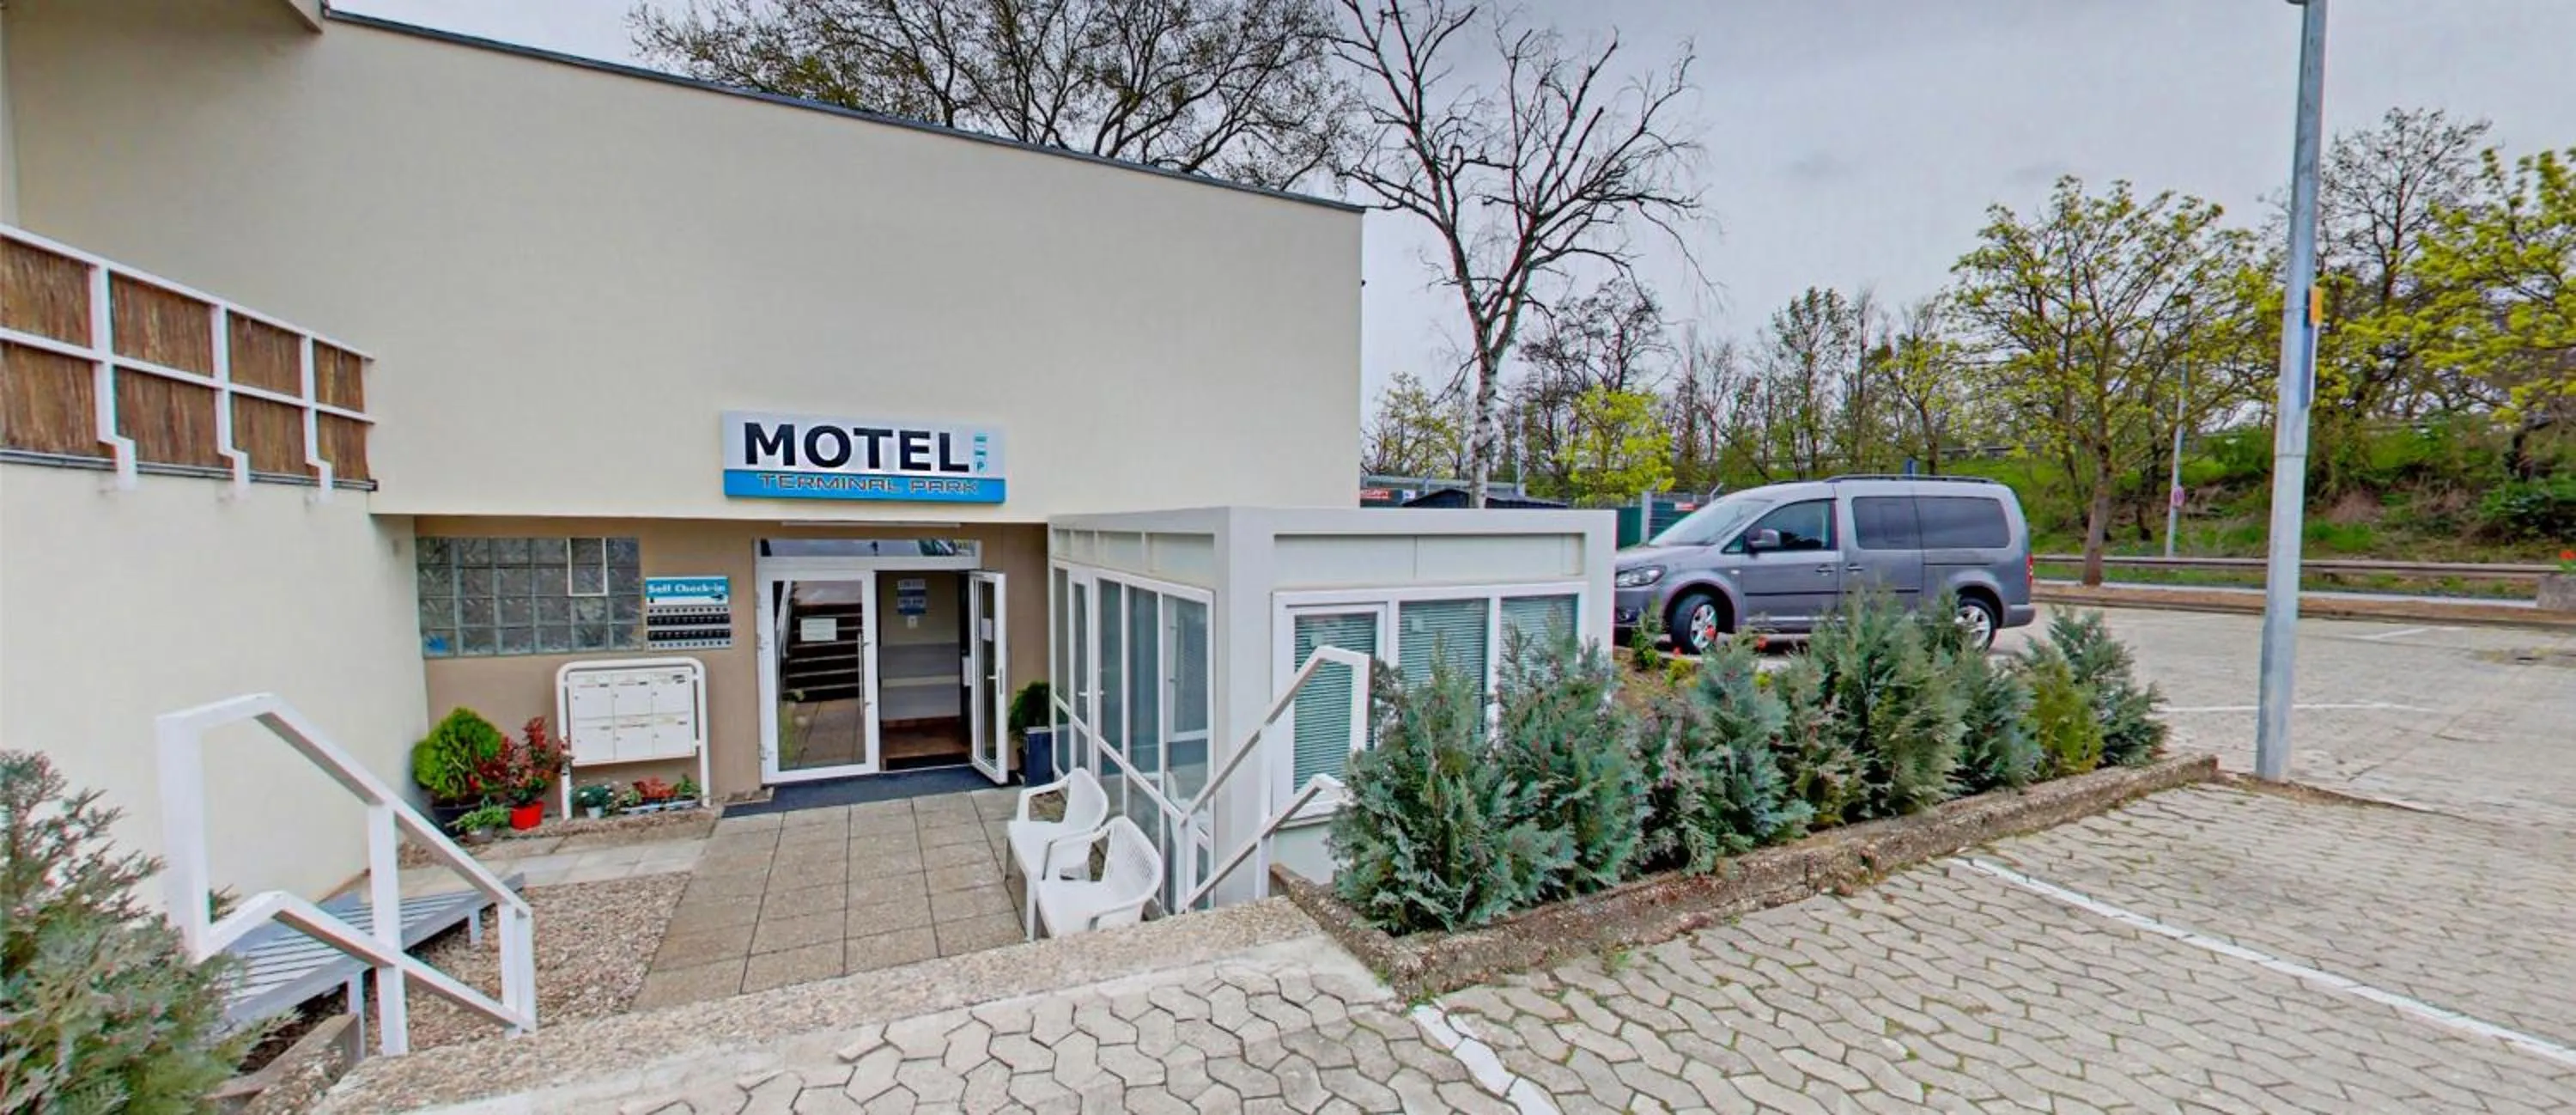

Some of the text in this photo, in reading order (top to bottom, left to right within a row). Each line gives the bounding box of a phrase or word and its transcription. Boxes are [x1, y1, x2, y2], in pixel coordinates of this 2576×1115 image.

[744, 422, 969, 472] MOTEL
[758, 473, 979, 495] TERMINAL PARK
